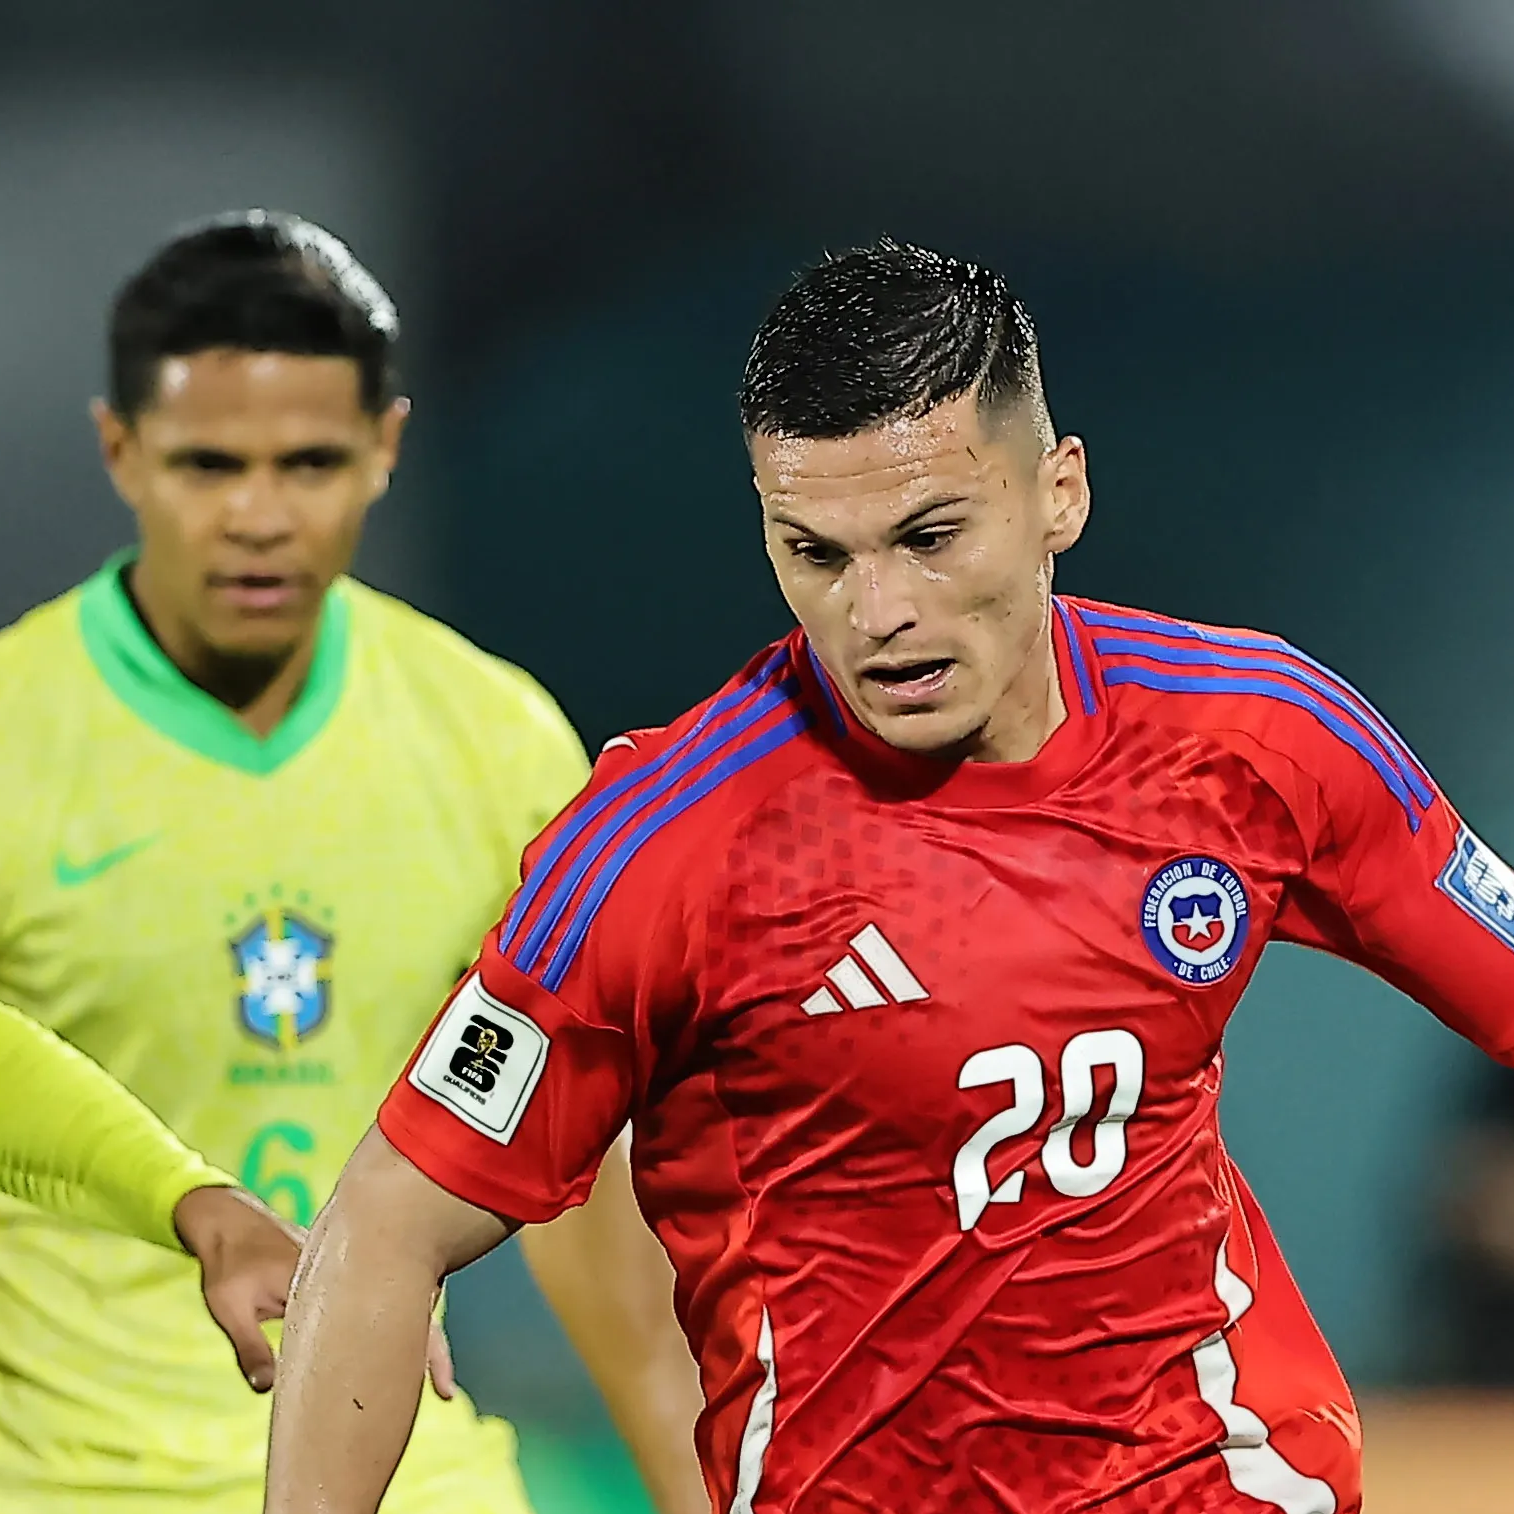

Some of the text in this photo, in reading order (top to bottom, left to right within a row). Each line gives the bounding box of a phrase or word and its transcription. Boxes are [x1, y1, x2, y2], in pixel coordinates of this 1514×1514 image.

[1144, 862, 1247, 928] FEDERACION DE FUTBOL
[1178, 956, 1230, 980] DE CHILE
[461, 1066, 484, 1085] FIFA
[952, 1029, 1145, 1231] 20
[241, 1122, 315, 1228] 6
